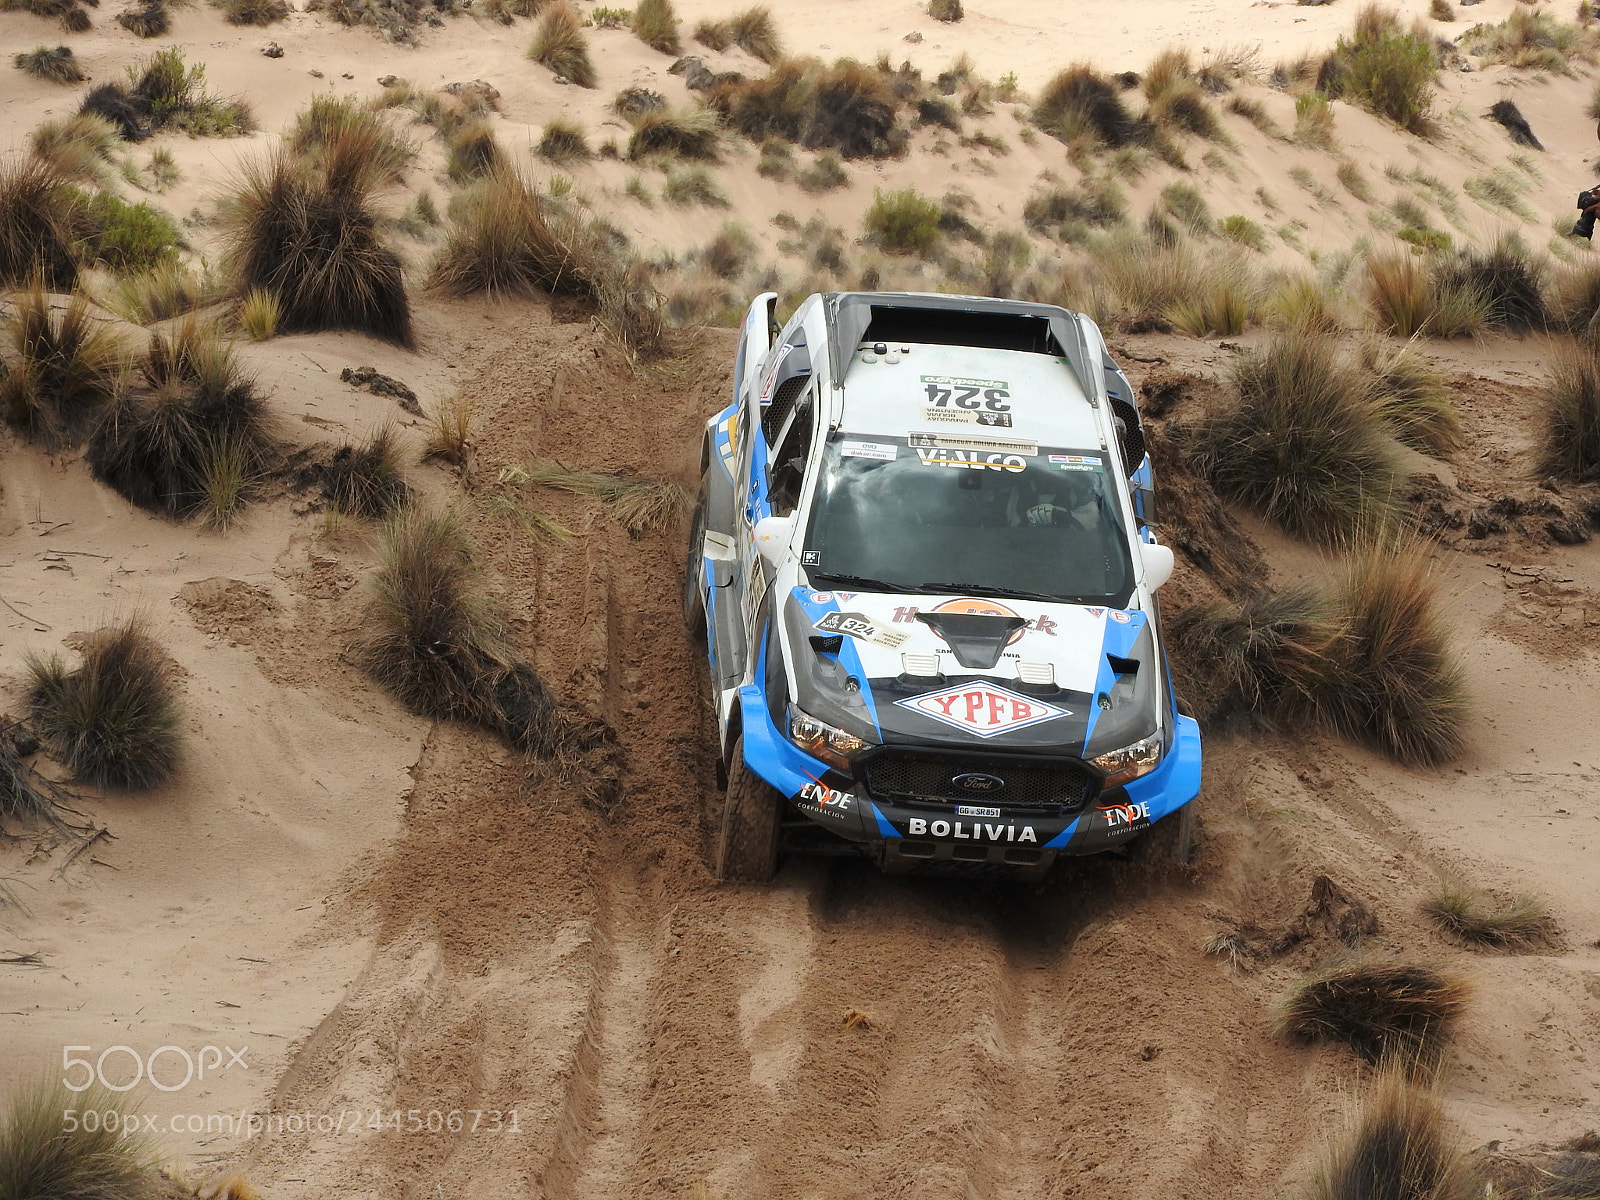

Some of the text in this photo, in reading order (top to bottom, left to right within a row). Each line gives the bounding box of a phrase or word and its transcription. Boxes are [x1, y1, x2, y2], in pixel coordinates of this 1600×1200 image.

[924, 375, 1005, 389] SpeedAgro
[924, 384, 1011, 411] 324
[844, 620, 875, 635] 324
[934, 691, 1032, 725] YPFB
[964, 776, 993, 789] Ford
[800, 782, 855, 810] ENDE
[1105, 801, 1151, 827] ENDE
[909, 818, 1037, 843] BOLIVIA
